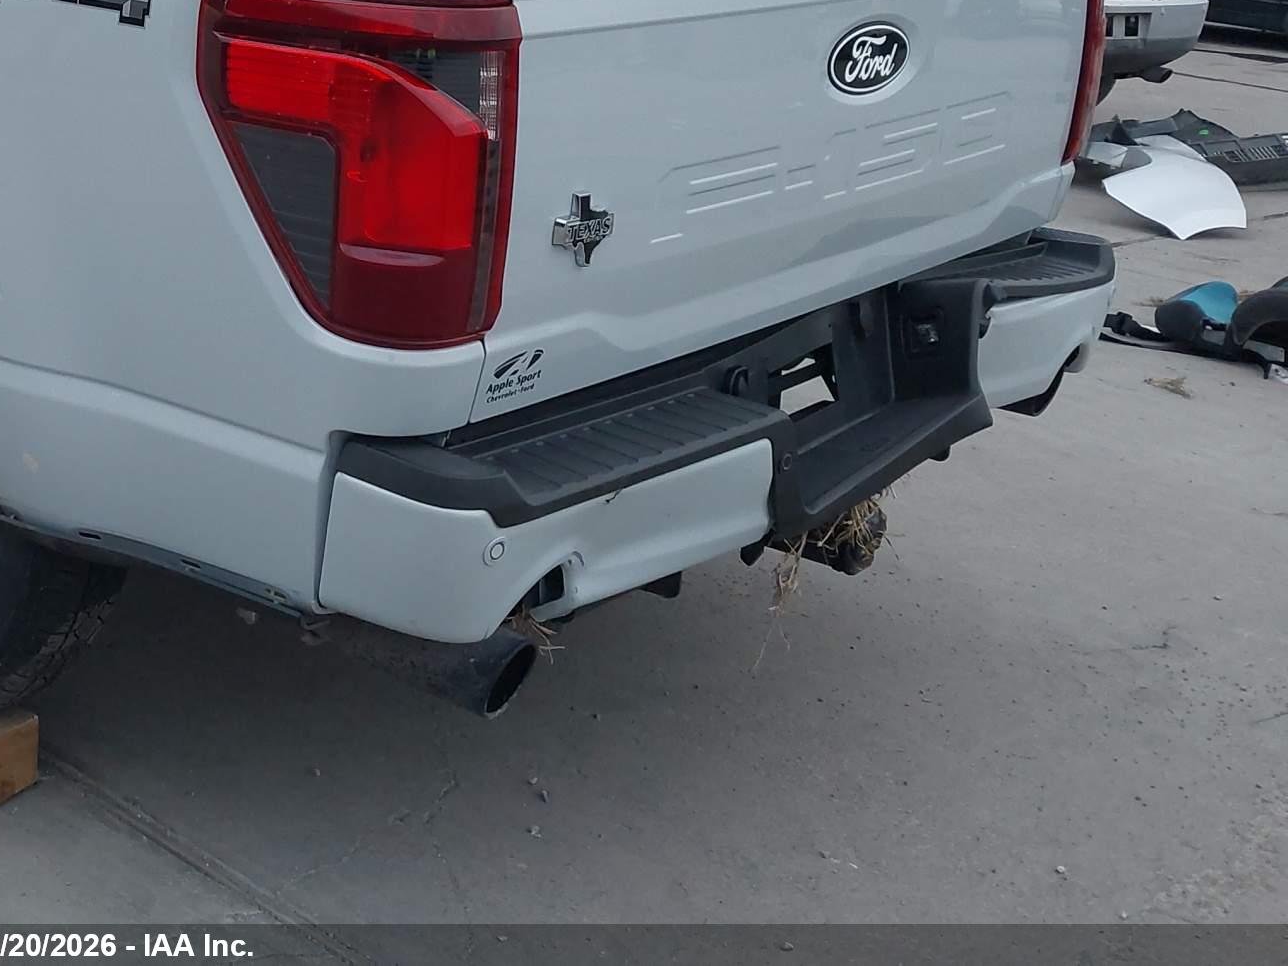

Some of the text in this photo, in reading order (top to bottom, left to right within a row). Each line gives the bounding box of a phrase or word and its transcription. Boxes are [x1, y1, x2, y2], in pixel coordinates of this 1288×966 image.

[844, 35, 898, 83] Ford
[567, 216, 614, 243] TEXAS
[486, 370, 541, 394] Apple Sport
